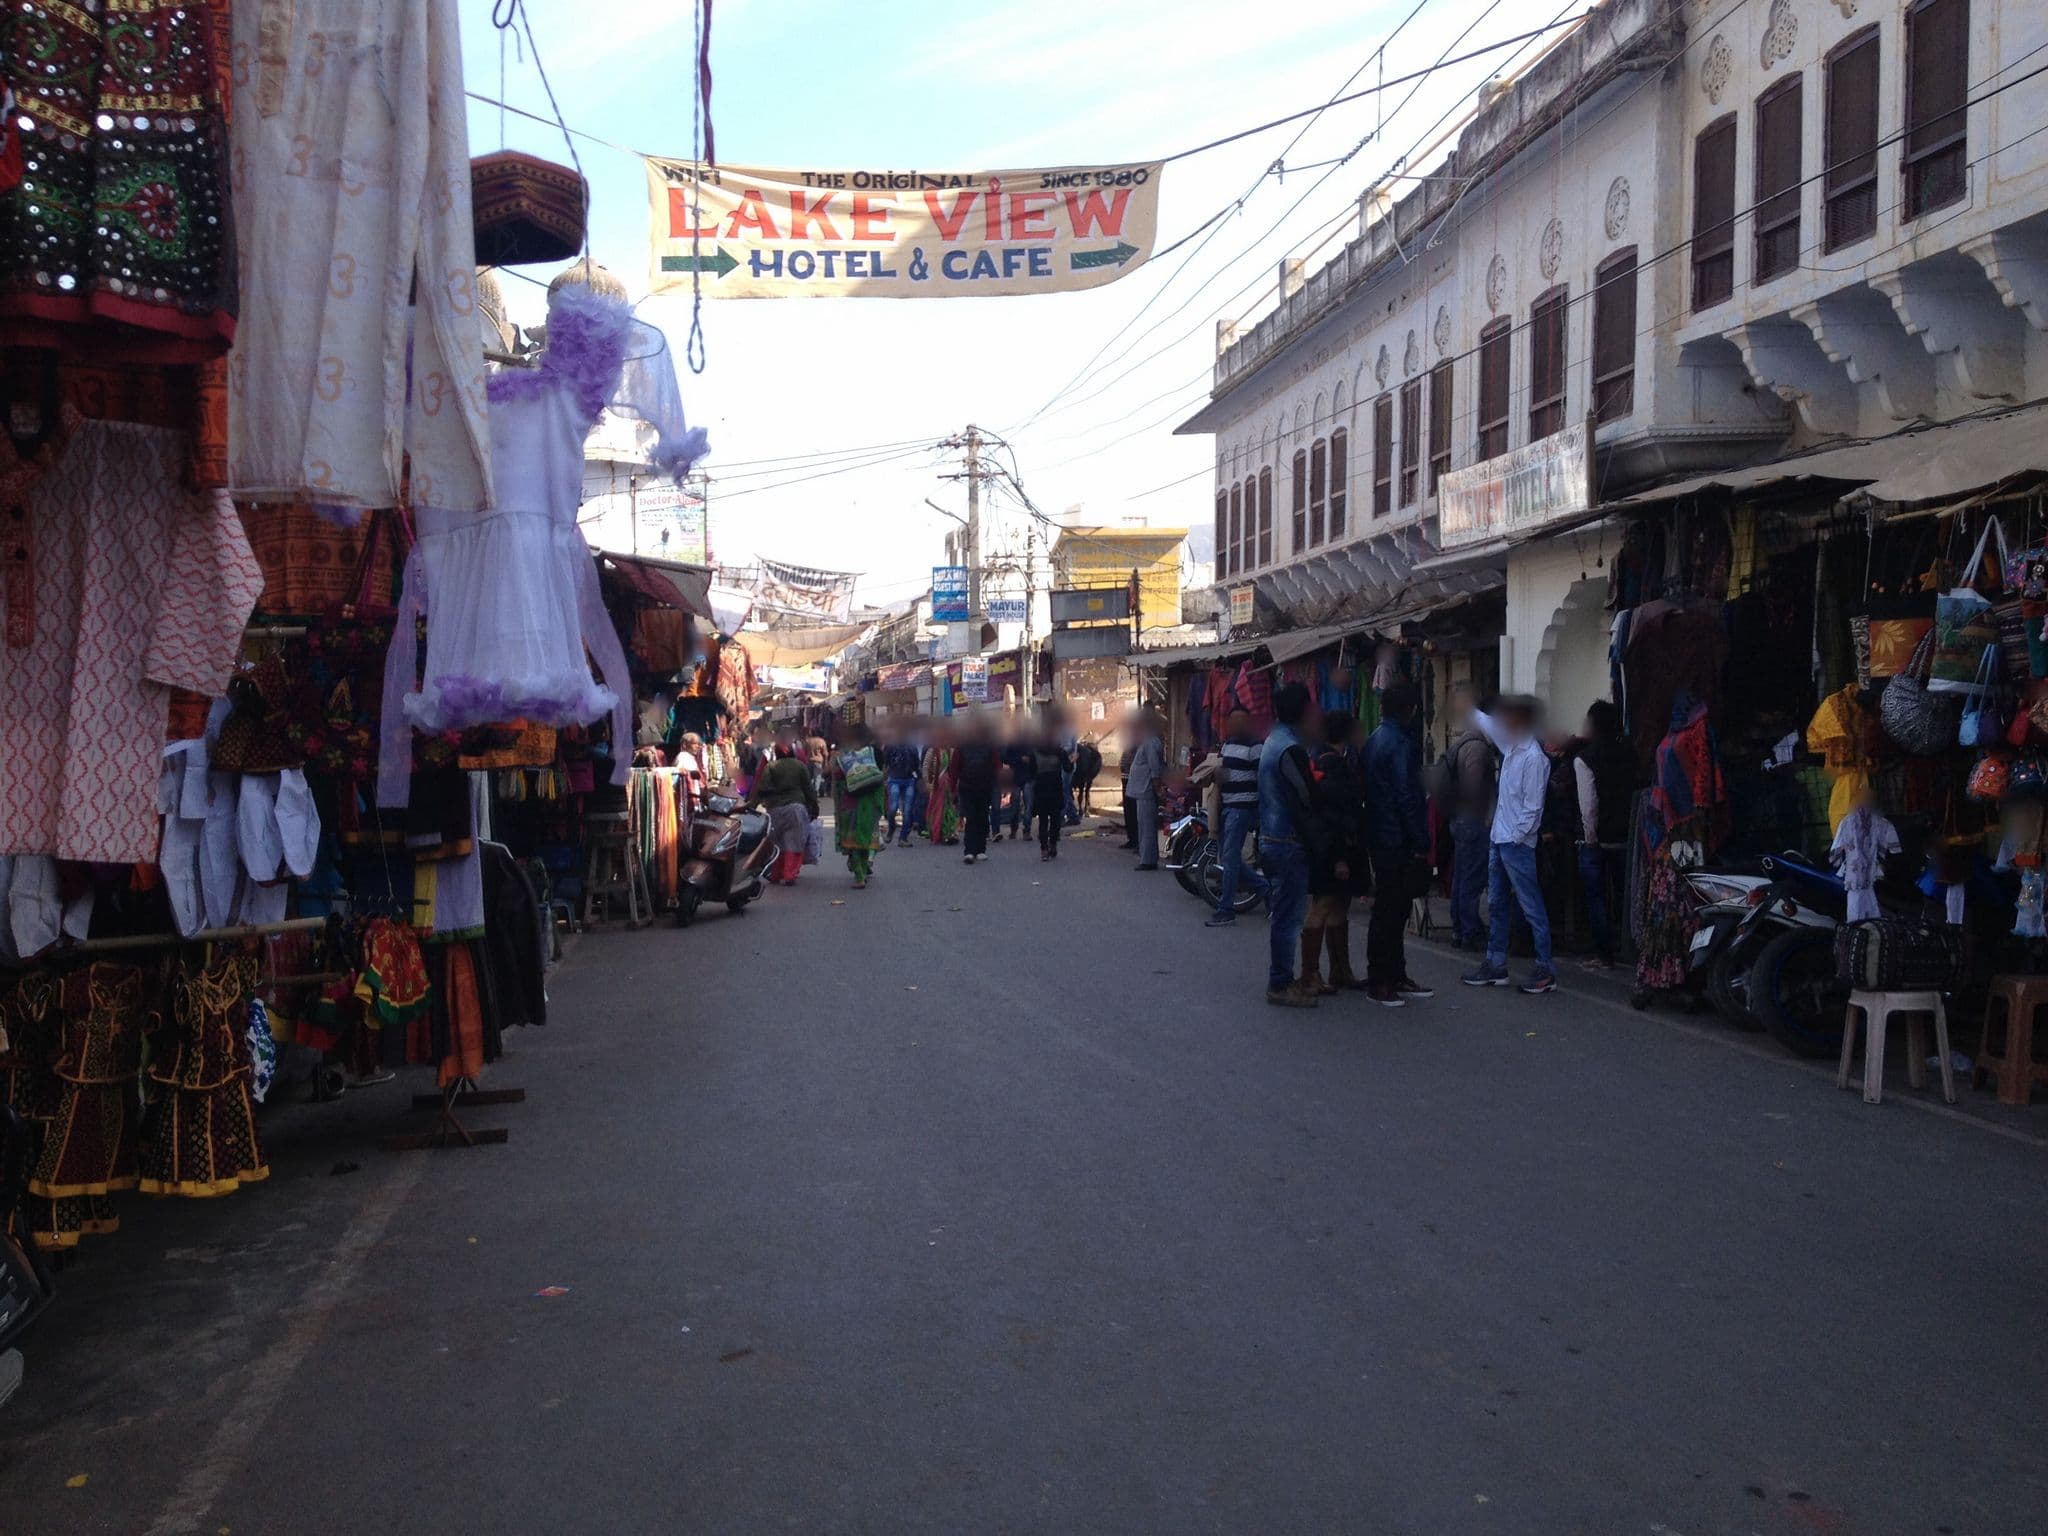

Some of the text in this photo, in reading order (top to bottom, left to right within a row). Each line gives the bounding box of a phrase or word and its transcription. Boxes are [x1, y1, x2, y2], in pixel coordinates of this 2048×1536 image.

[800, 171, 846, 189] THE
[1039, 167, 1149, 190] SINCE 1980
[668, 176, 1133, 241] LAKE VIEW
[747, 246, 1053, 281] HOTEL & CAFE
[990, 601, 1025, 611] MAYUR
[963, 672, 986, 680] PALACE
